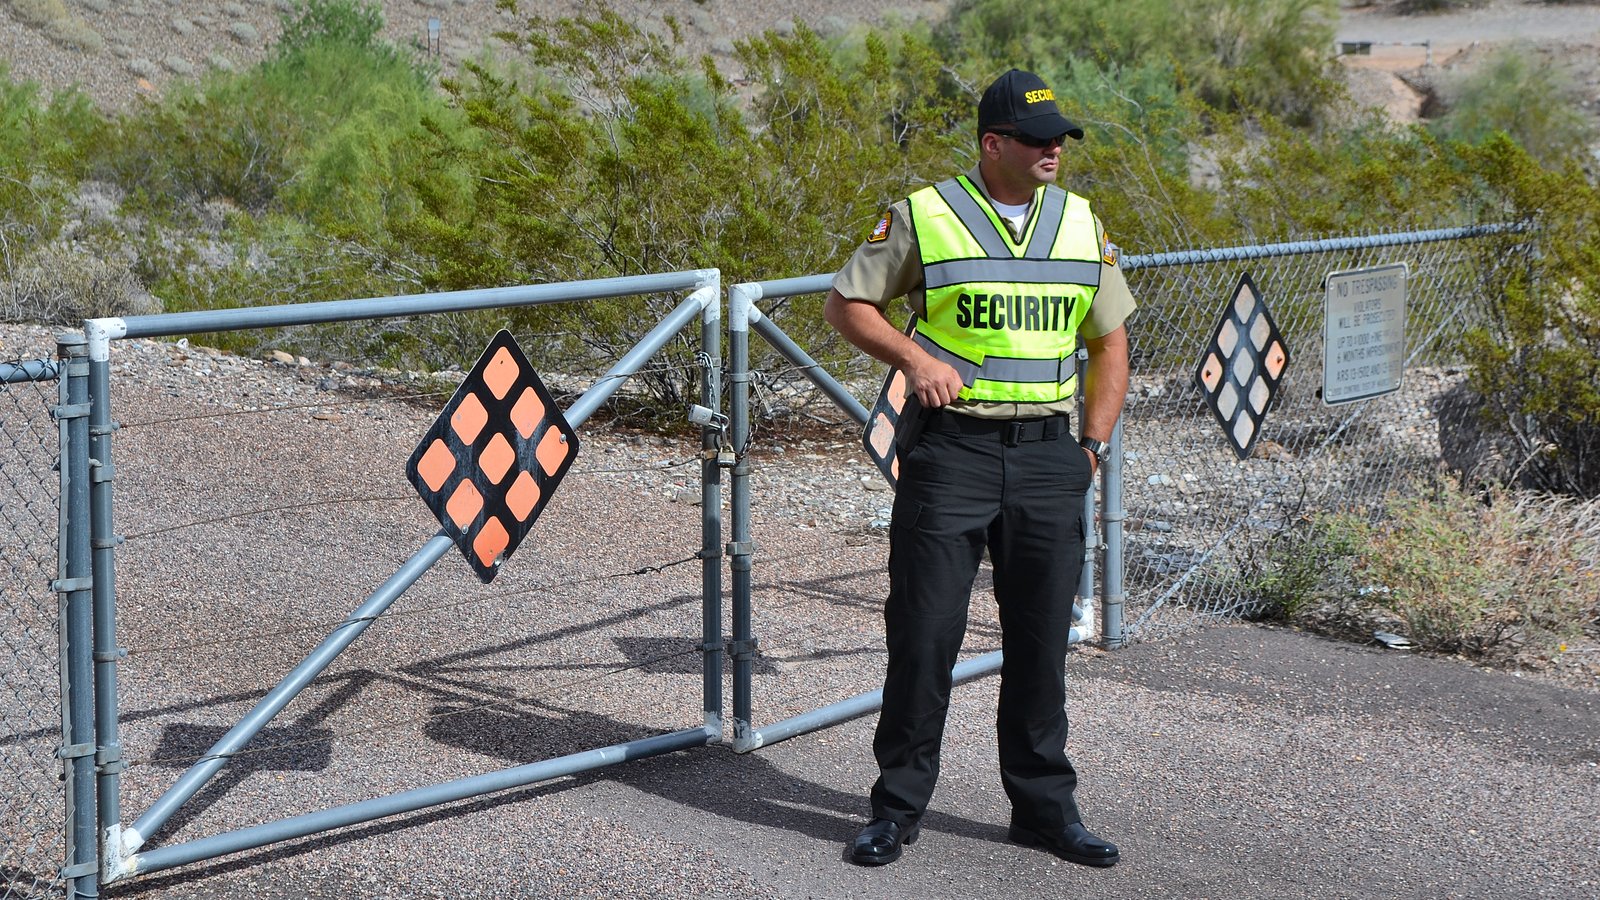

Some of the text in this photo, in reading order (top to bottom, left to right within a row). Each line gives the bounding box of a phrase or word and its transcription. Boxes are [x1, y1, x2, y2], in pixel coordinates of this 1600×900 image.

[1337, 274, 1398, 298] NO TRESPASSING
[956, 293, 1076, 332] SECURITY
[1354, 298, 1382, 313] VIOLATORS
[1339, 316, 1351, 329] WILL
[1354, 314, 1361, 328] BE
[1337, 336, 1346, 349] UP
[1346, 335, 1353, 348] TO
[1343, 347, 1366, 363] MONTHS
